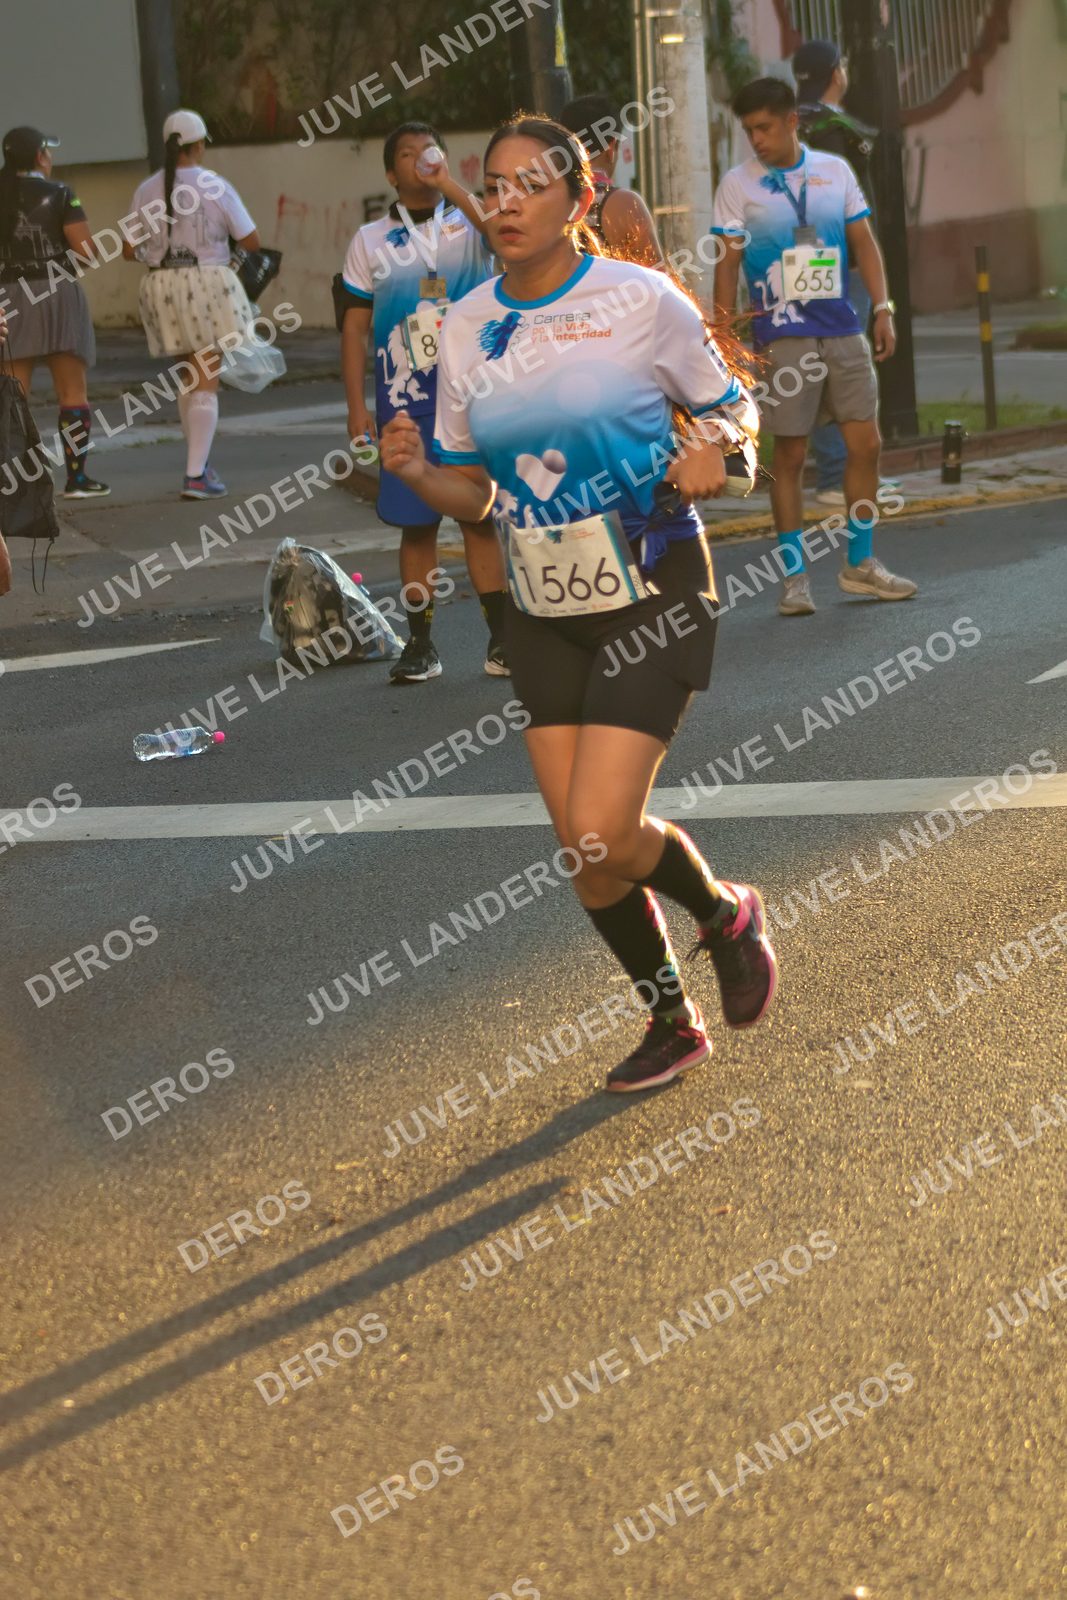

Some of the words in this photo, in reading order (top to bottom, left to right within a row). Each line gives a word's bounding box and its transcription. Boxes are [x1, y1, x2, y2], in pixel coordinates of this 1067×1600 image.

[794, 269, 834, 293] 655
[534, 312, 591, 325] Carrera
[519, 557, 621, 604] 1566
